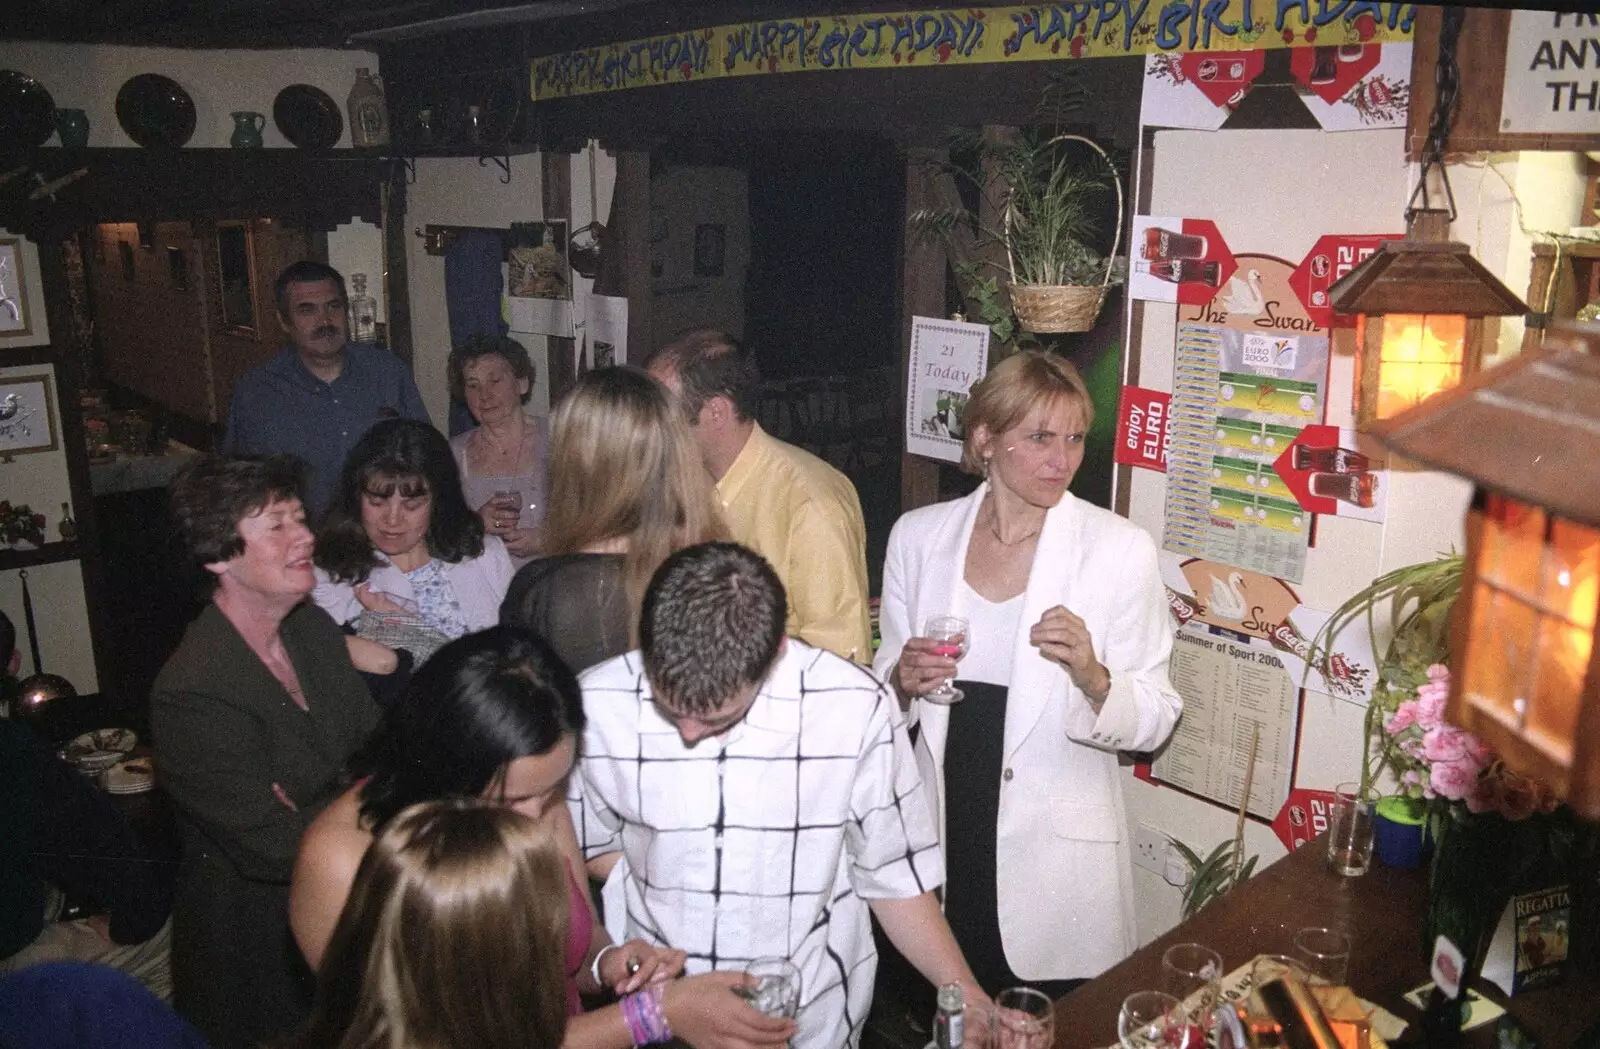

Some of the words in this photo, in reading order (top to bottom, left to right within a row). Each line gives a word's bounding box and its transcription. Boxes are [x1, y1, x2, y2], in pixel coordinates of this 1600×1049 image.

[1010, 0, 1149, 52] HAPPY
[726, 20, 820, 70] HAPPY
[1545, 81, 1600, 112] TH
[940, 344, 956, 357] 21
[1244, 354, 1269, 363] 2000
[1245, 346, 1269, 356] EURO
[925, 362, 970, 388] Today
[1126, 403, 1145, 449] enjoy
[1143, 401, 1163, 460] EURO
[1175, 629, 1213, 650] Summer
[1216, 643, 1226, 653] of
[1228, 645, 1256, 662] Sport
[1515, 891, 1571, 918] REGATTA
